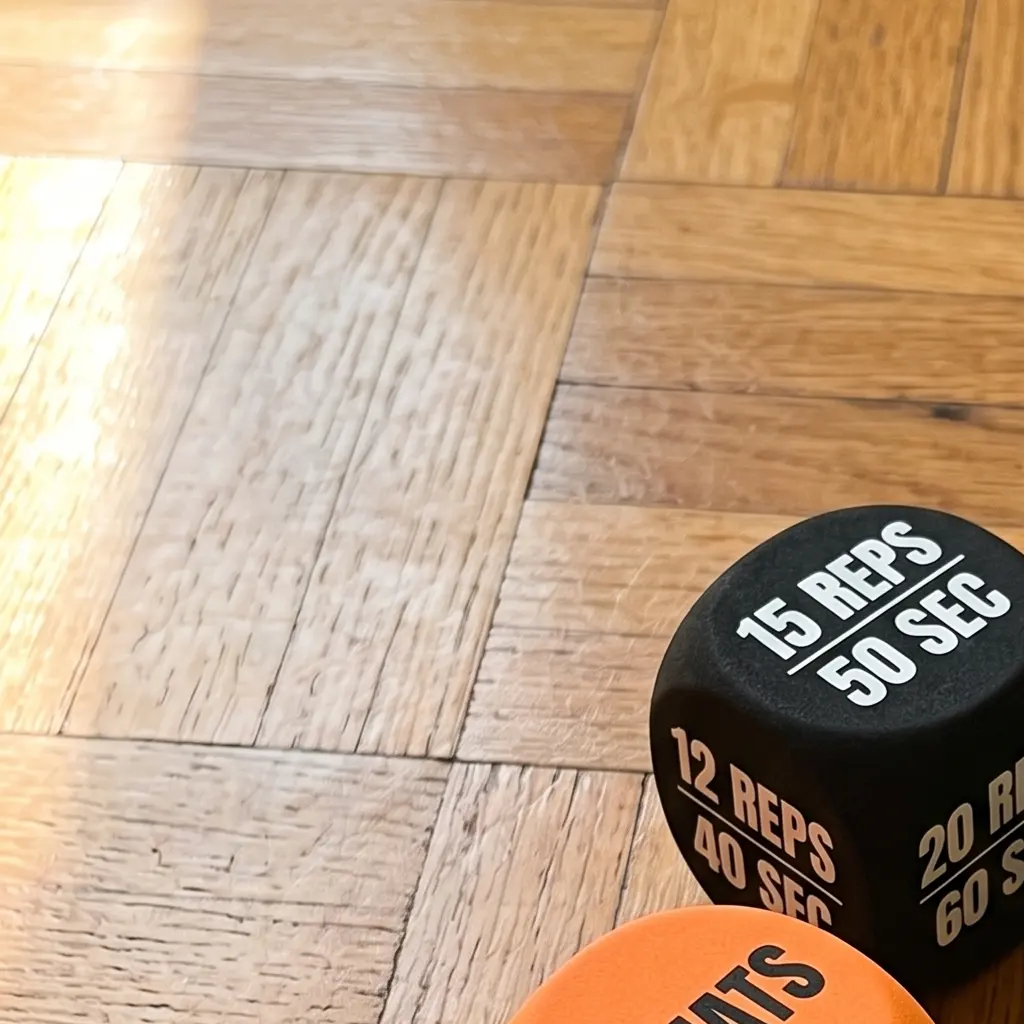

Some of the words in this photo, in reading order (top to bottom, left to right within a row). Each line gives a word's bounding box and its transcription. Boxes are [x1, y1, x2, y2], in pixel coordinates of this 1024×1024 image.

[736, 597, 822, 661] 15
[797, 521, 942, 621] REPS
[816, 636, 917, 707] 50
[895, 572, 1011, 655] SEC
[671, 727, 719, 805] 12
[730, 763, 836, 884] REPS
[694, 814, 746, 890] 40
[918, 802, 973, 890] 20
[936, 867, 989, 947] 60
